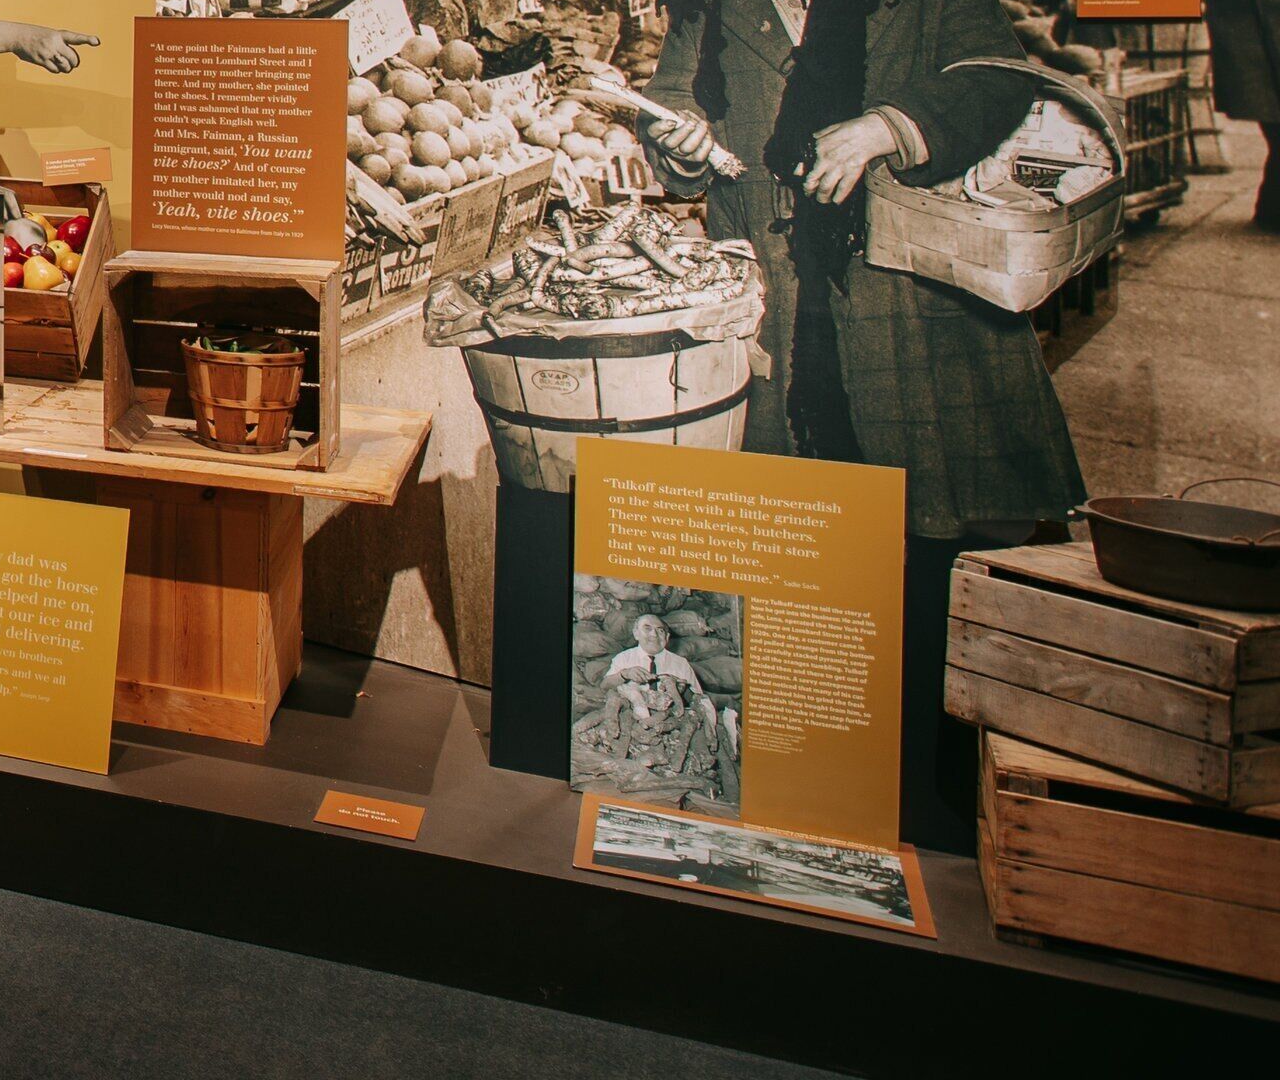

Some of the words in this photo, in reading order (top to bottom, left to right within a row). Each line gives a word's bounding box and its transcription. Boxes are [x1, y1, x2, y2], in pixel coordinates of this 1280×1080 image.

[185, 44, 208, 54] point
[210, 44, 225, 53] the
[227, 44, 266, 54] Faimans
[268, 45, 286, 54] had
[296, 46, 317, 55] little
[611, 156, 648, 190] 10
[206, 205, 238, 220] vite
[658, 485, 703, 498] started
[707, 491, 756, 506] grating
[760, 494, 841, 514] horseradish
[7, 551, 34, 567] dad
[39, 559, 67, 572] was
